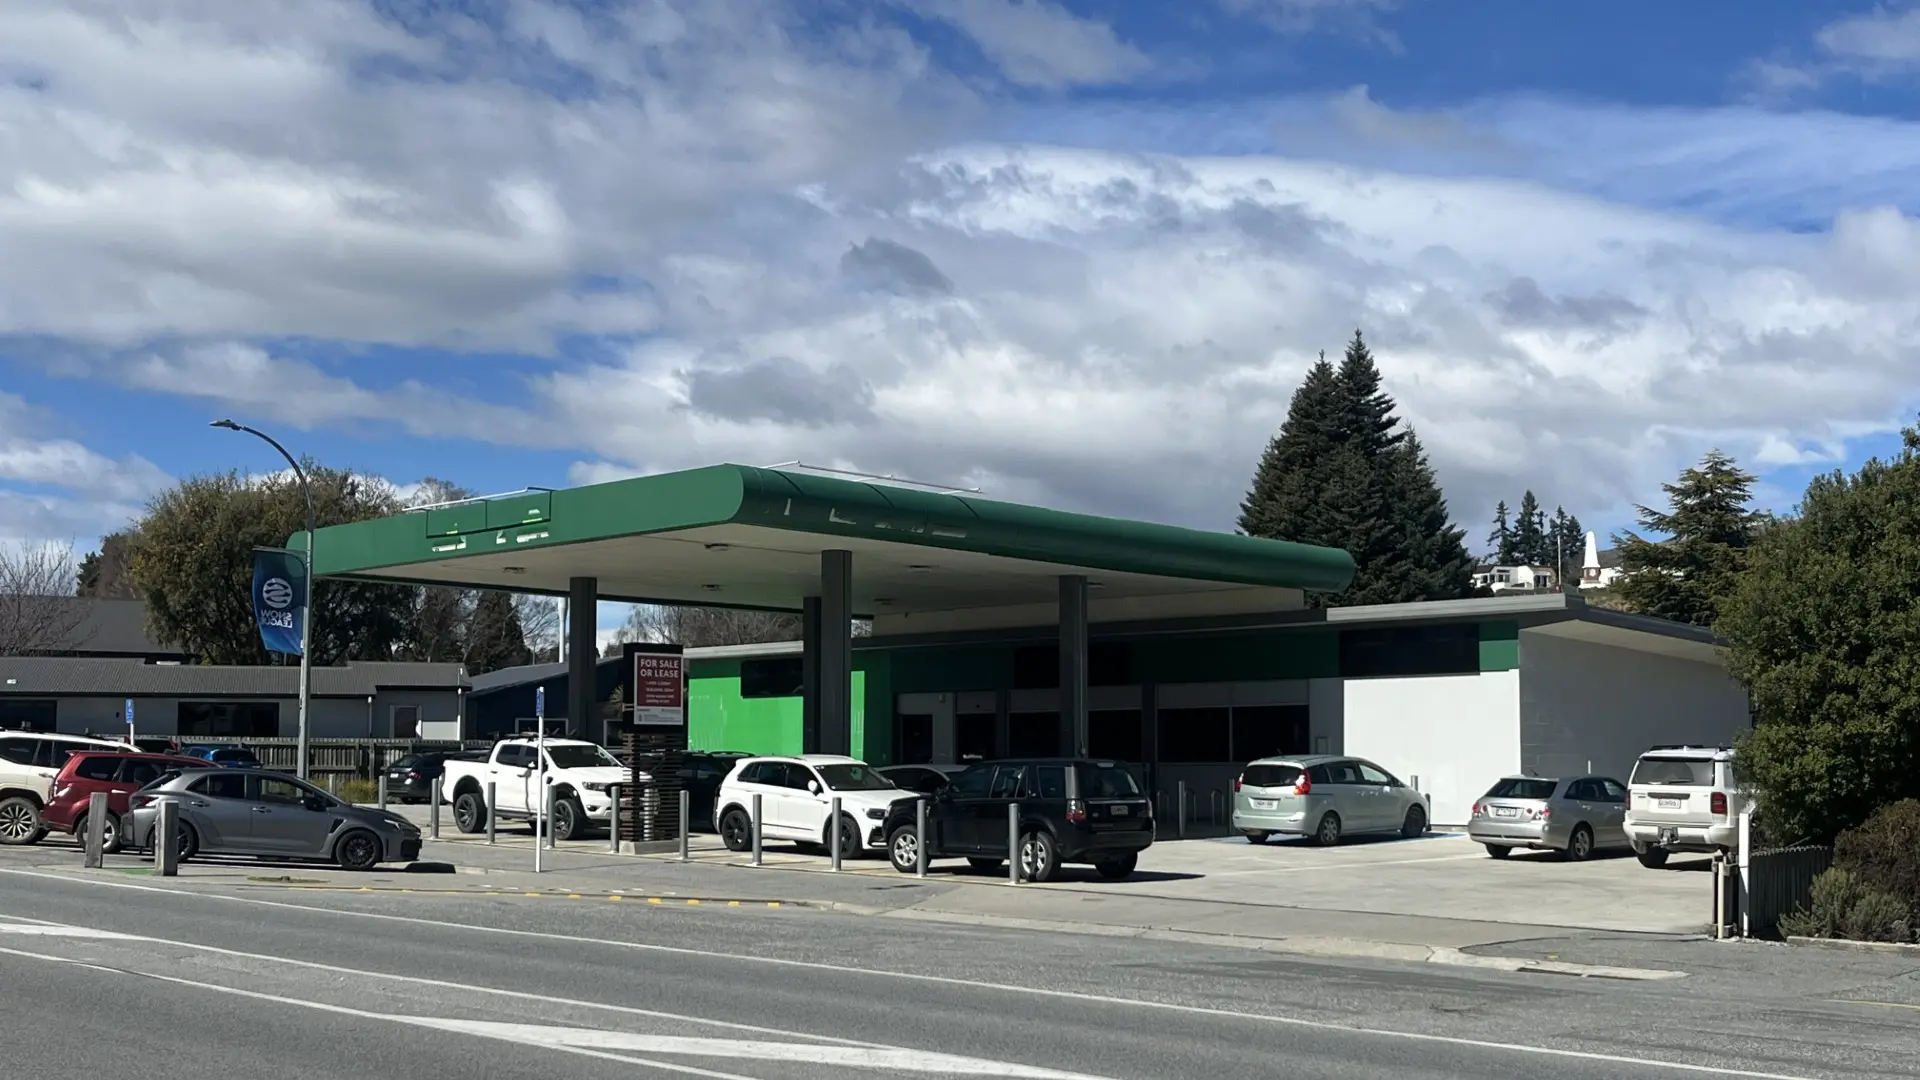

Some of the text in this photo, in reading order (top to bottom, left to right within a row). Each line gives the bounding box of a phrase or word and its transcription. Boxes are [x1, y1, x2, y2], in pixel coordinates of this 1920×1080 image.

[640, 659, 679, 669] FOR SALE
[640, 669, 679, 678] OR LEASE
